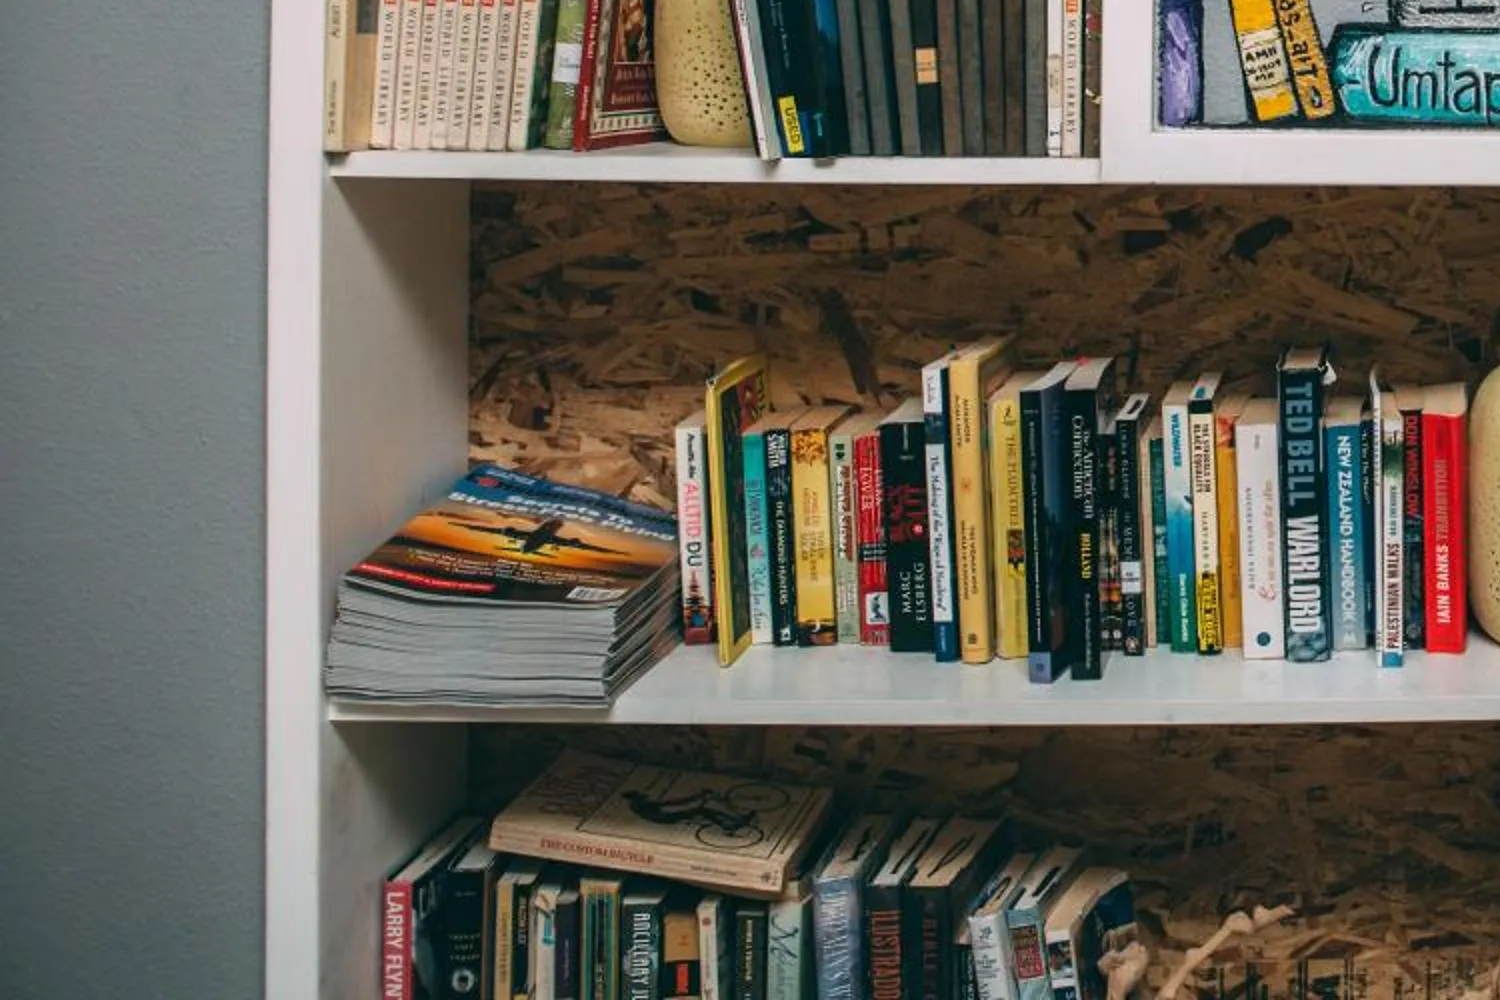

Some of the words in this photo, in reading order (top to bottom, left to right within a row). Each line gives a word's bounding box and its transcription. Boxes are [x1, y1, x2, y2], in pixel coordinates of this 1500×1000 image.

[382, 11, 394, 58] WORLD
[405, 7, 419, 55] WORLD
[423, 13, 436, 61] WORLD
[443, 8, 456, 55] WORLD
[459, 13, 473, 61] WORLD
[479, 13, 493, 61] WORLD
[499, 11, 513, 60] WORLD
[518, 10, 534, 56] WORLD
[377, 70, 389, 126] LIBRARY
[400, 65, 413, 122] LIBRARY
[418, 70, 431, 127] LIBRARY
[436, 66, 448, 122] LIBRARY
[452, 71, 467, 128] LIBRARY
[473, 70, 487, 127] LIBRARY
[491, 70, 506, 127] LIBRARY
[1284, 382, 1313, 434] TED
[1406, 416, 1418, 444] DON
[767, 434, 779, 468] SMITH
[1072, 415, 1087, 500] Connection
[1194, 424, 1202, 451] BLACK
[1337, 436, 1352, 467] NEW
[860, 466, 872, 511] LOVER
[930, 456, 941, 473] The
[1083, 449, 1096, 519] American
[1195, 454, 1204, 493] EQUALITY
[1204, 480, 1212, 493] FOR
[1286, 439, 1315, 507] BELL
[1407, 451, 1419, 518] WINSLOW
[775, 501, 786, 517] THE
[930, 475, 942, 507] Making
[1339, 471, 1354, 536] ZEALAND
[1435, 460, 1449, 541] TRANSITION
[686, 542, 703, 566] DU
[776, 519, 786, 563] DIAMOND
[1080, 533, 1092, 579] HOLLAND
[1387, 542, 1402, 579] WALKS
[778, 566, 789, 605] HUNTERS
[1287, 515, 1320, 633] WARLORD
[1340, 539, 1356, 622] HANDBOOK
[1438, 545, 1450, 589] BANKS
[900, 572, 911, 614] MARC
[914, 563, 926, 621] ELSBERG
[1126, 594, 1137, 627] LOVE
[1386, 582, 1401, 649] PALESTINIAN
[1437, 595, 1451, 624] IAIN
[540, 838, 560, 852] THE
[386, 891, 404, 950] LARRY
[631, 913, 651, 985] ANCILLARY
